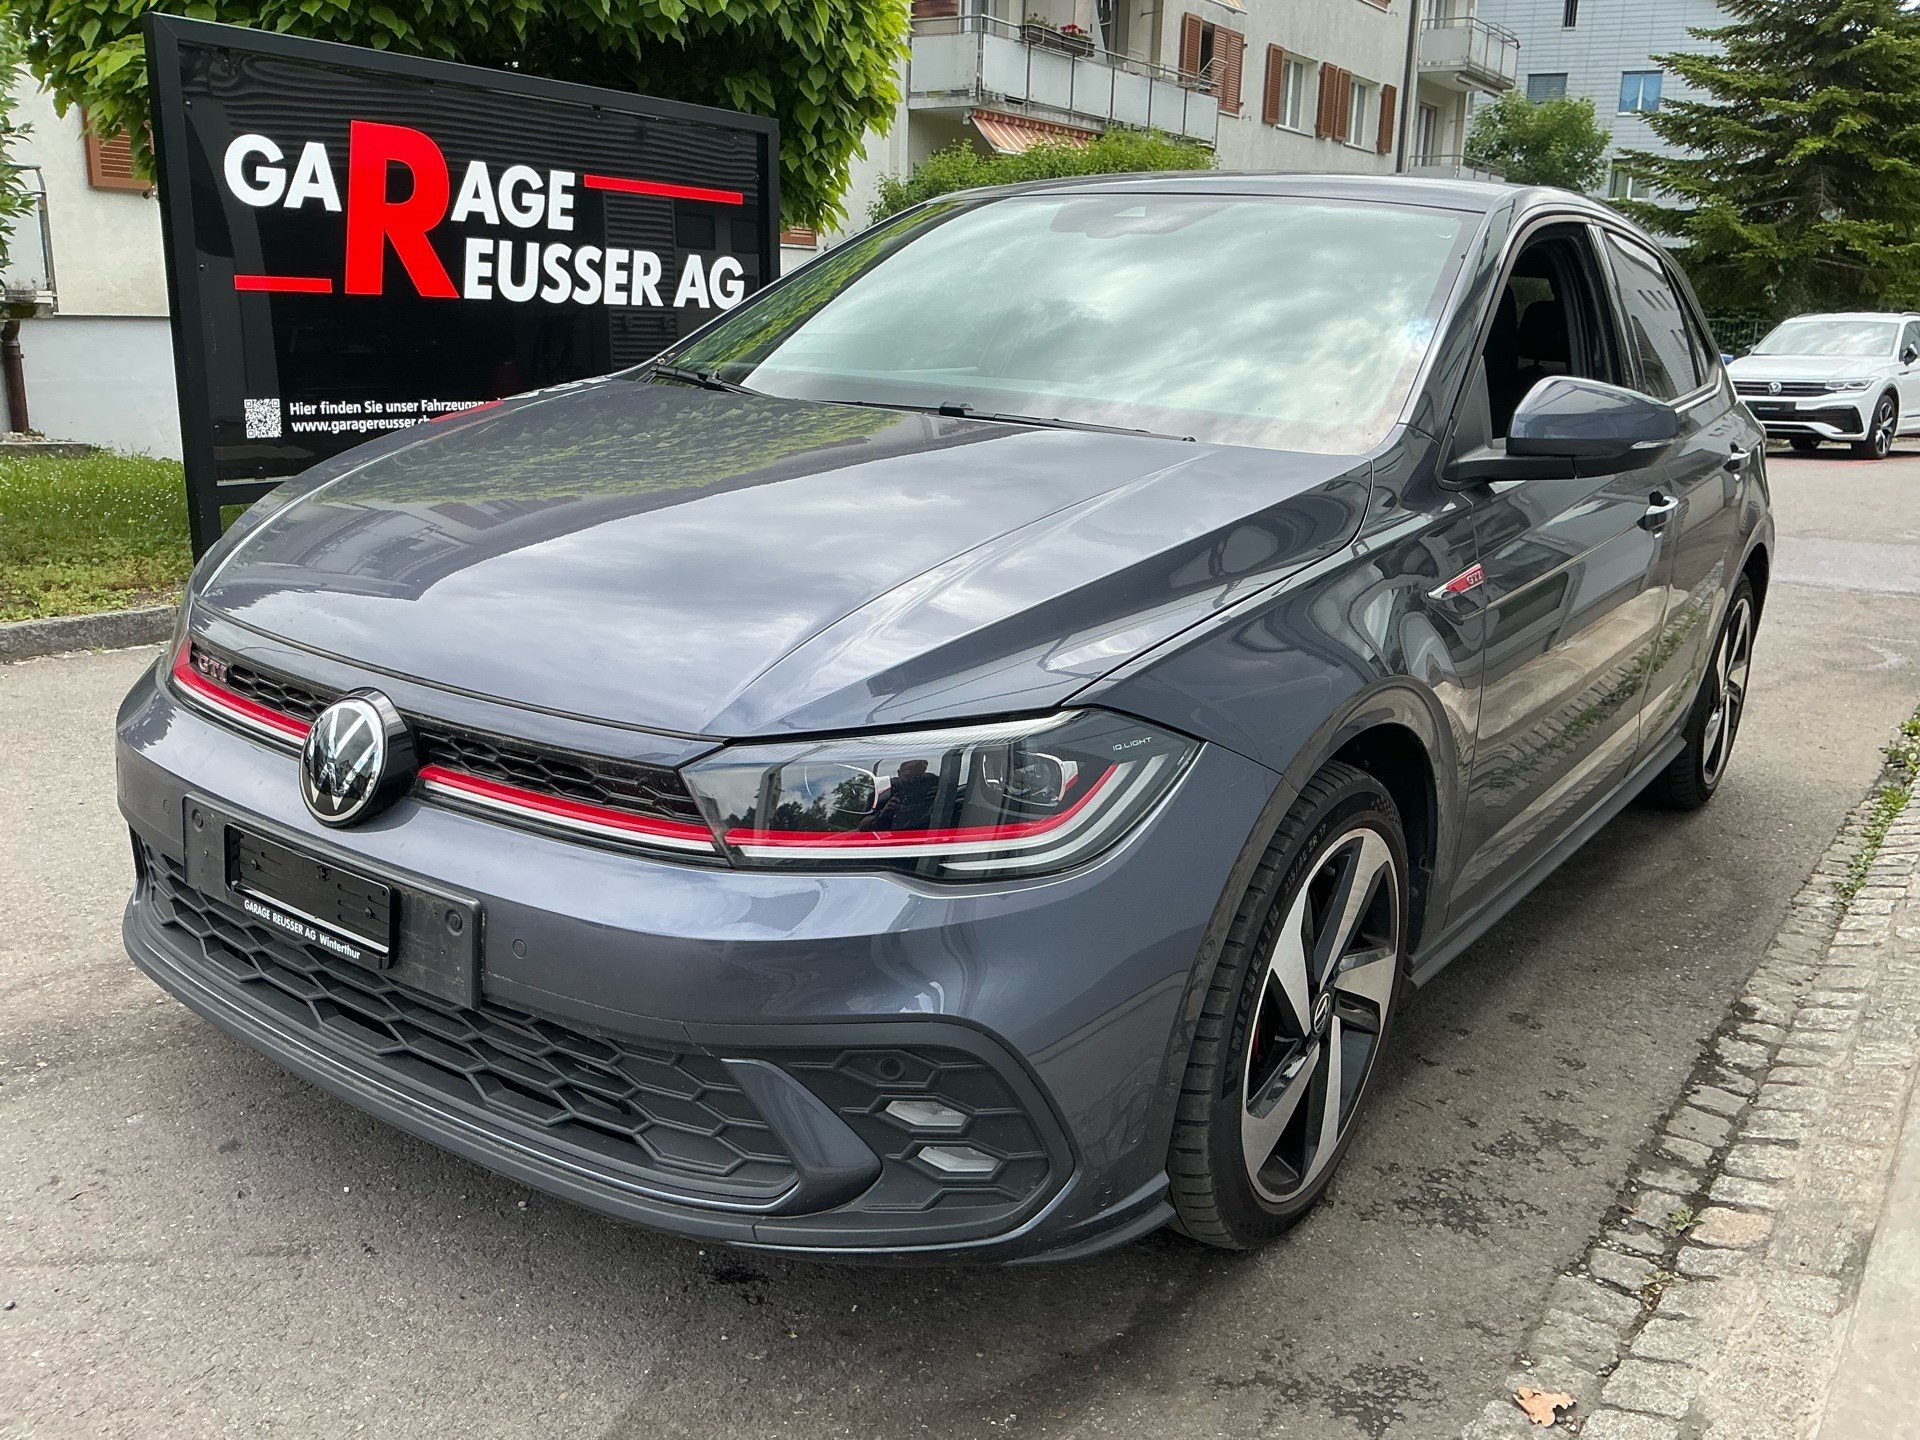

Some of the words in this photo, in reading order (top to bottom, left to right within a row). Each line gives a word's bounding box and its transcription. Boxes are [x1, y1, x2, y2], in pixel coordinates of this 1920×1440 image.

[223, 119, 576, 298] GARAGE
[674, 256, 745, 309] AG
[289, 402, 317, 415] Hier
[320, 400, 362, 415] finden
[364, 401, 383, 413] Sie
[386, 402, 419, 413] unser
[1466, 570, 1482, 585] GTI
[197, 654, 228, 683] GTI
[1112, 736, 1152, 751] IQ.LIGHT
[1319, 823, 1327, 837] 17
[244, 899, 271, 920] GARAGE
[272, 912, 304, 936] REUSSER
[304, 927, 317, 941] AG
[319, 933, 361, 960] Winterthur
[1232, 903, 1281, 1051] MICHELIN
